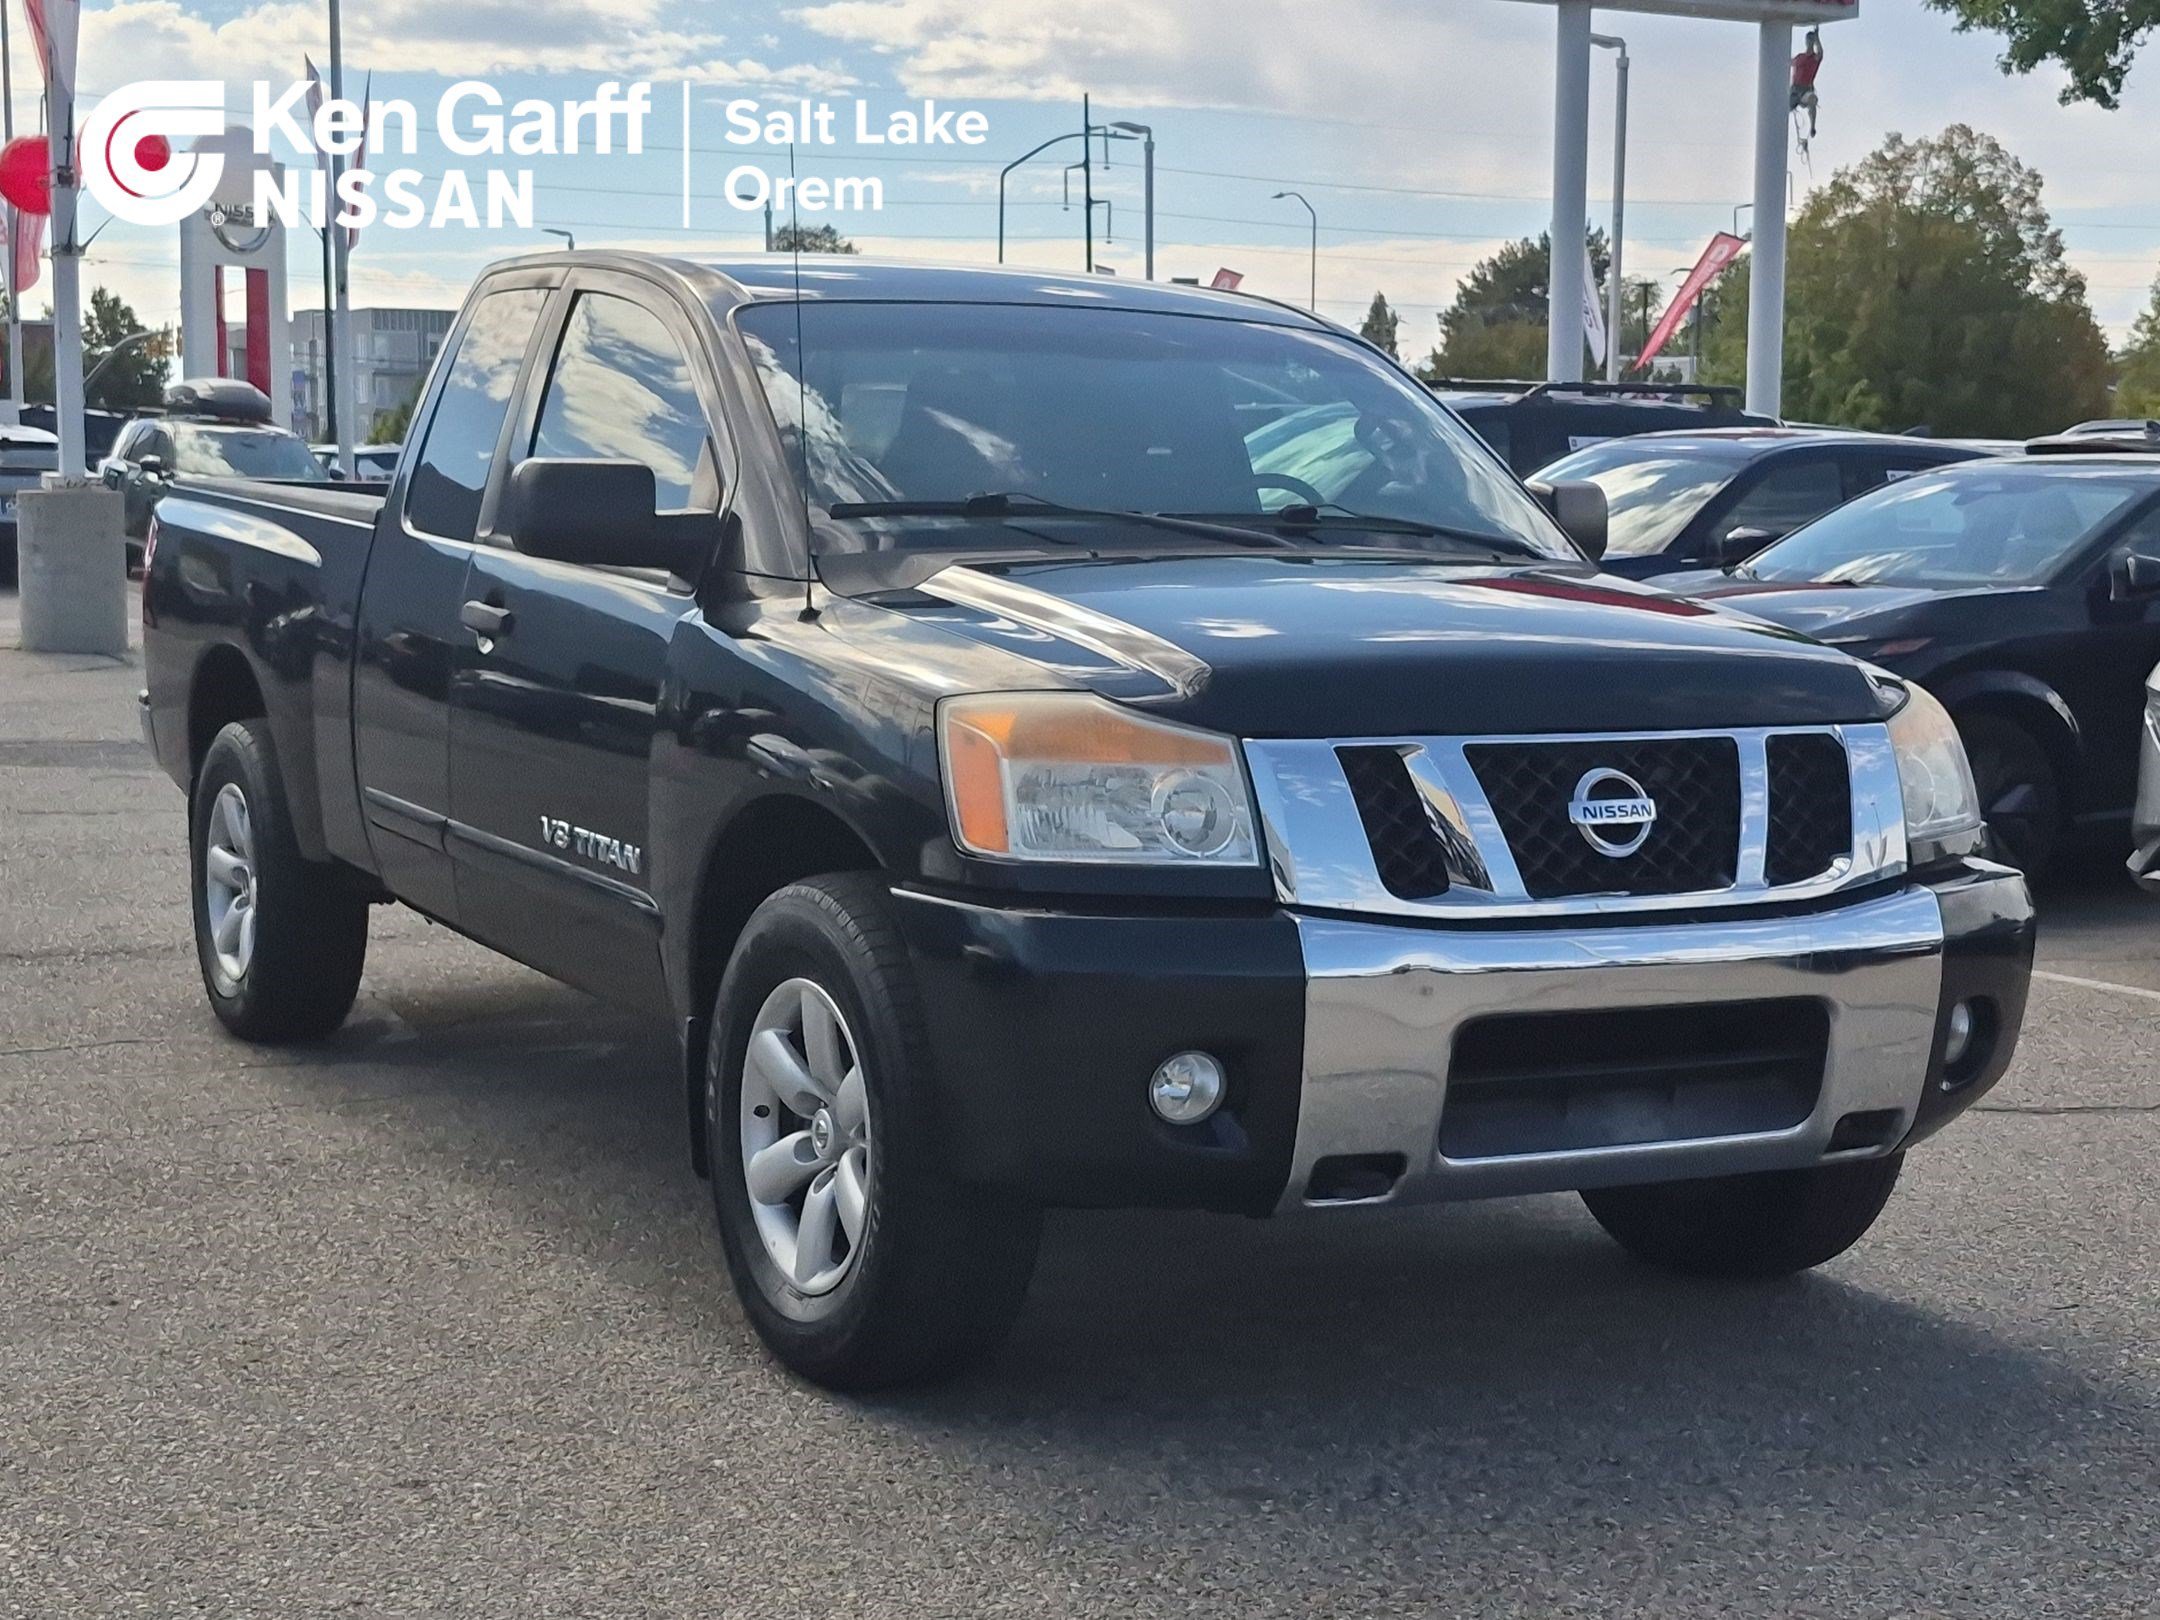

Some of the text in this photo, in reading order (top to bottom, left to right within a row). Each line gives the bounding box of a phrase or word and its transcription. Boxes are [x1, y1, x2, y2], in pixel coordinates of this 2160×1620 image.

[1582, 804, 1652, 819] NISSAN
[541, 815, 640, 874] V8 TITAN
